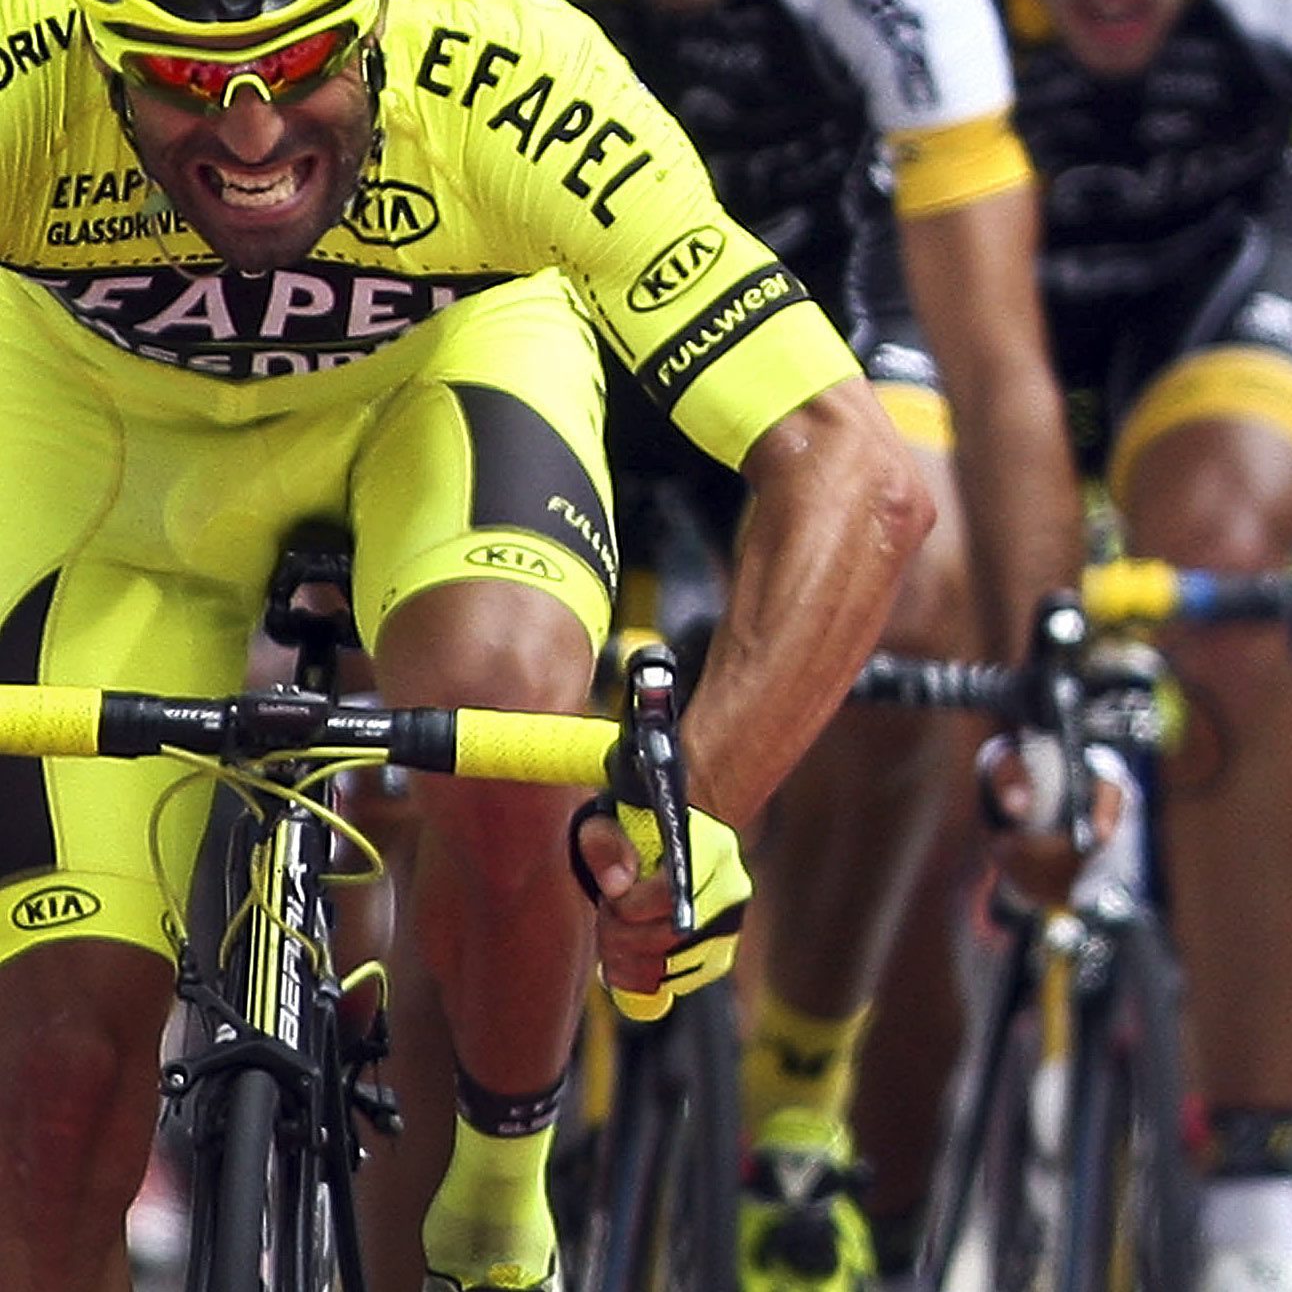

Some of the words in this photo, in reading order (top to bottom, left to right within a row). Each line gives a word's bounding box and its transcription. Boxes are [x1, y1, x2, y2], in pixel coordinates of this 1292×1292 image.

[416, 28, 652, 229] EFAPEL
[645, 237, 718, 302] KIA
[24, 894, 83, 926] KIA
